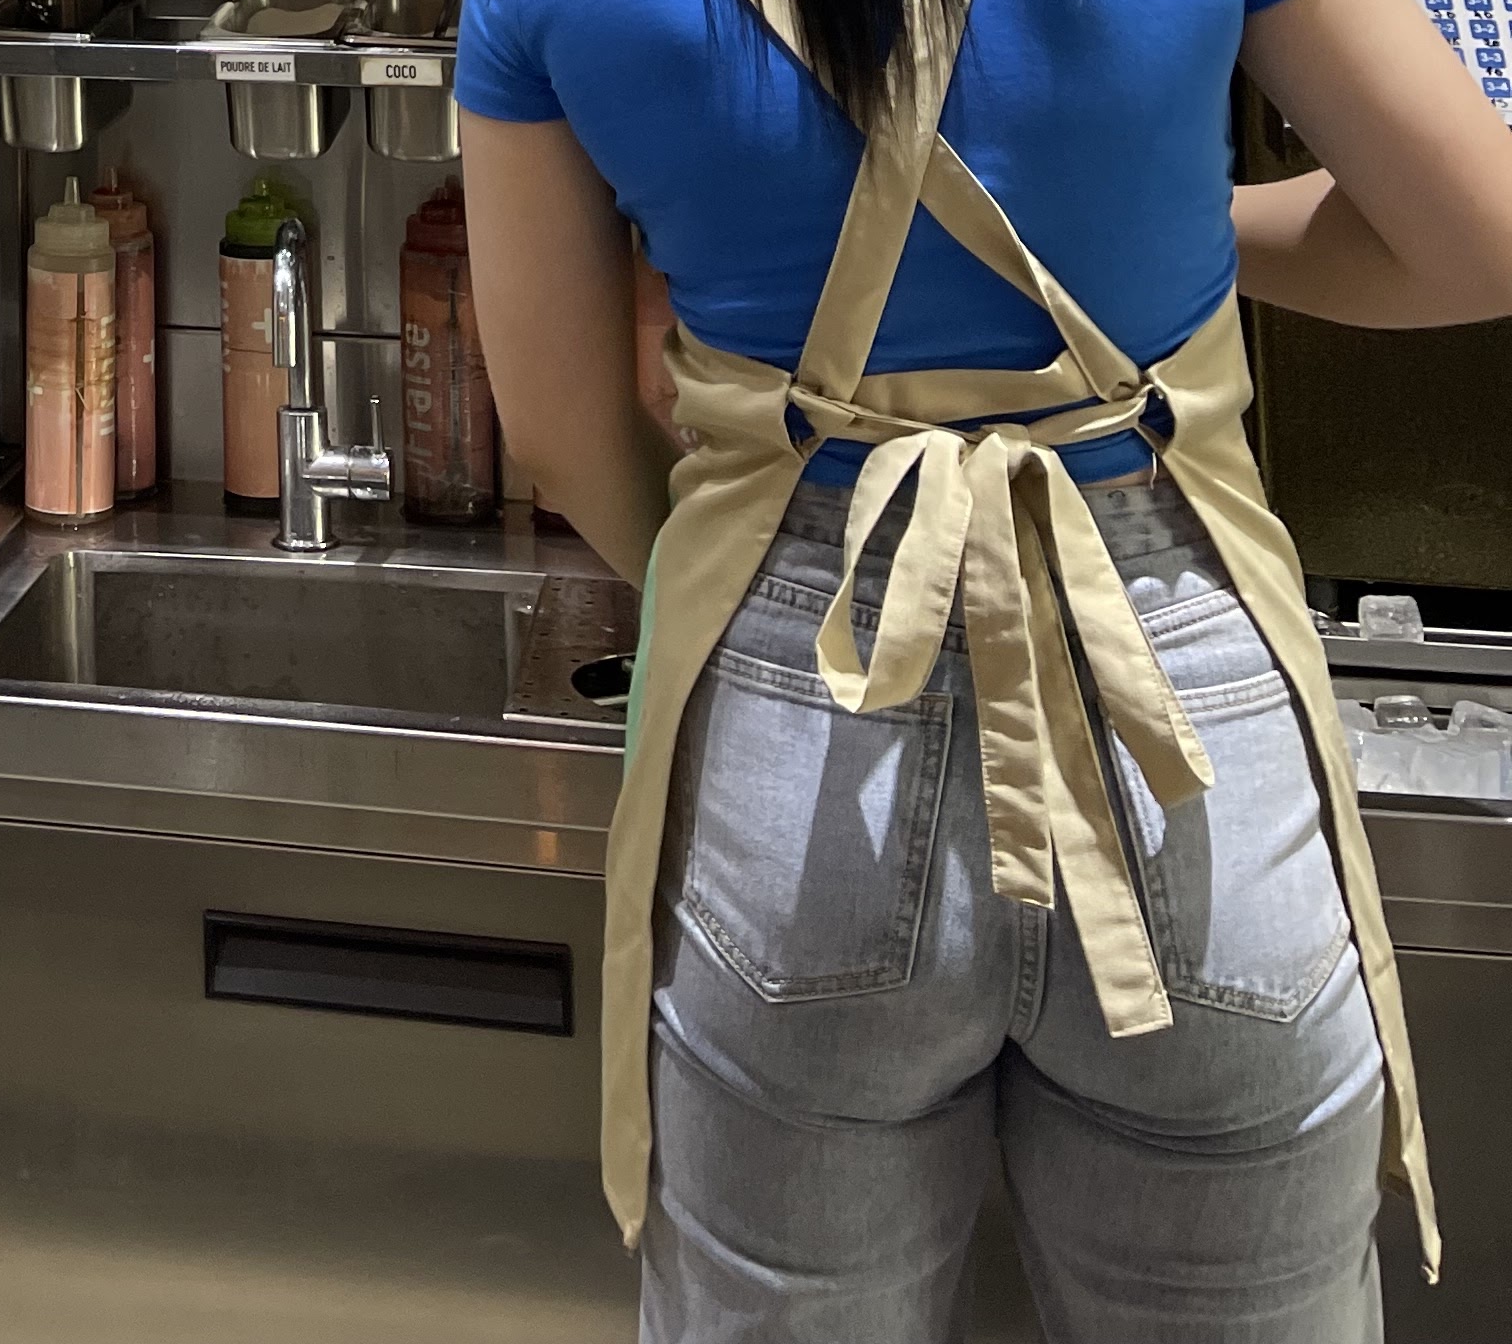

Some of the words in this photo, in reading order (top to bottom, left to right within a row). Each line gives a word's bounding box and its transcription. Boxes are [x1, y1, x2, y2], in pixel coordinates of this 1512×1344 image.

[1473, 23, 1496, 34] 3-2
[1480, 52, 1503, 63] 3-3
[220, 60, 255, 74] POUDRE
[258, 61, 270, 73] DE
[272, 61, 292, 73] LAIT
[385, 64, 417, 80] COCO
[1486, 81, 1509, 92] 3-4
